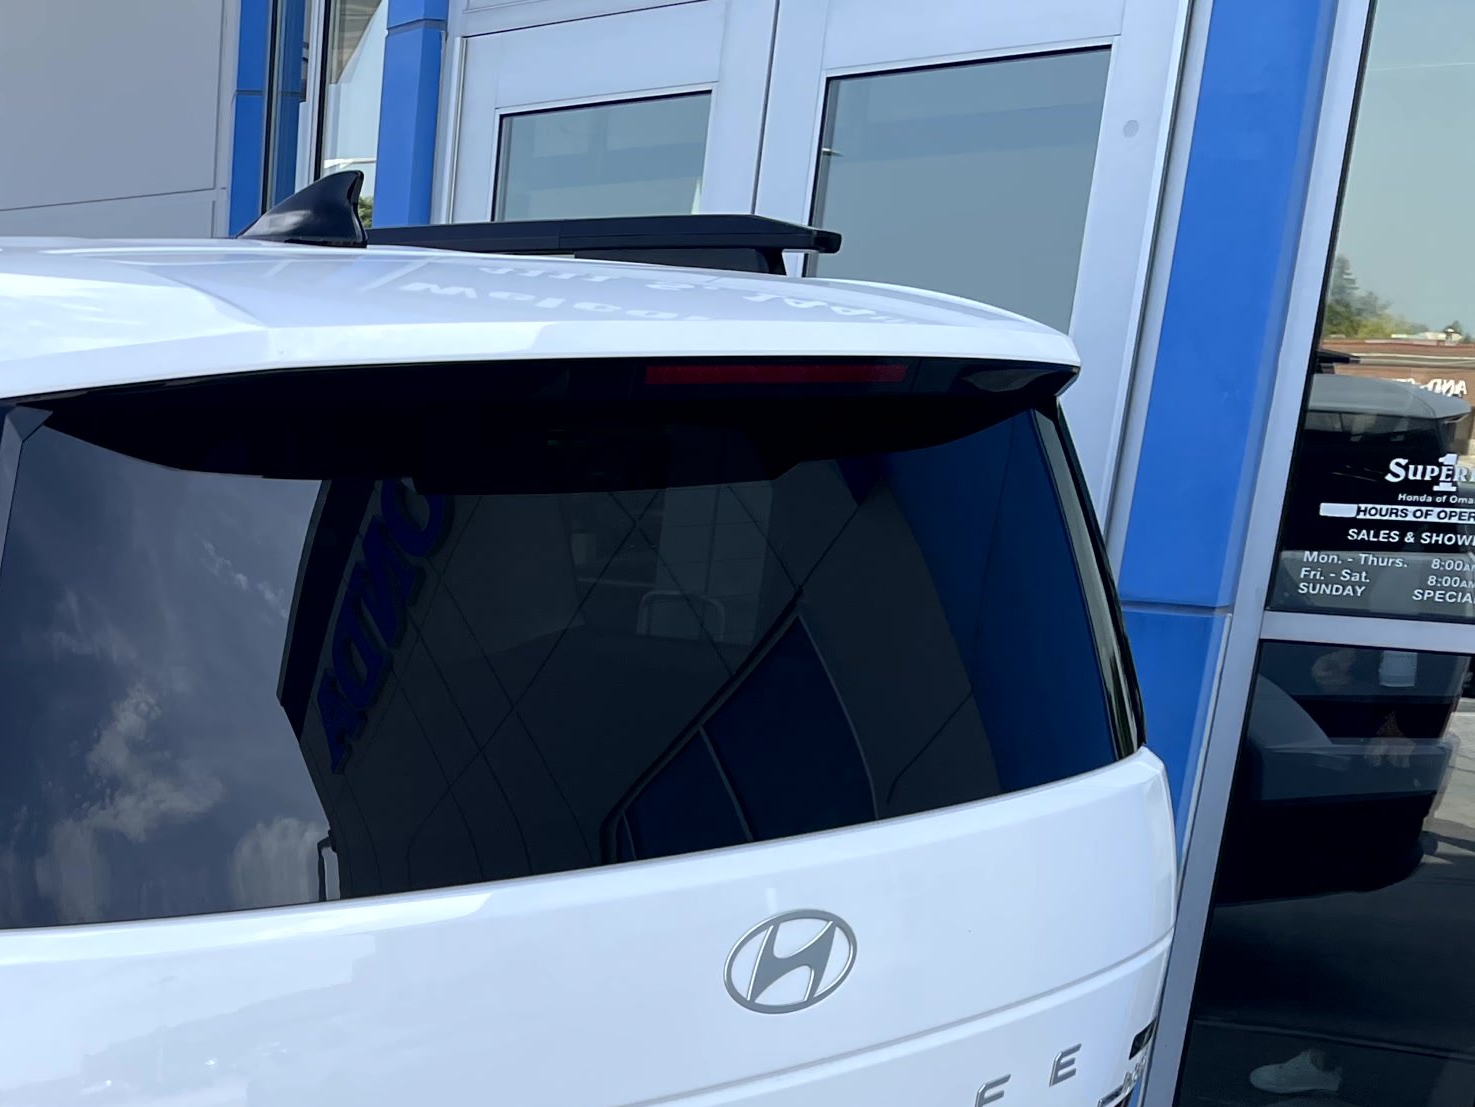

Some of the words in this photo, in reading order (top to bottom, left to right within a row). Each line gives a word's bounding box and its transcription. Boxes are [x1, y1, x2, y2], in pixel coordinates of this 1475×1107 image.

[1398, 493, 1433, 503] Honda
[1435, 494, 1449, 503] of
[1356, 505, 1409, 519] HOURS
[1412, 508, 1435, 520] OF
[1347, 528, 1400, 543] SALES
[1404, 531, 1416, 544] &
[1303, 550, 1343, 565] Mon.
[1358, 553, 1409, 568] Thurs.
[1300, 567, 1325, 580] Fri.
[1339, 569, 1371, 583] Sat.
[1298, 582, 1366, 597] SUNDAY
[1411, 588, 1475, 604] SPECIA
